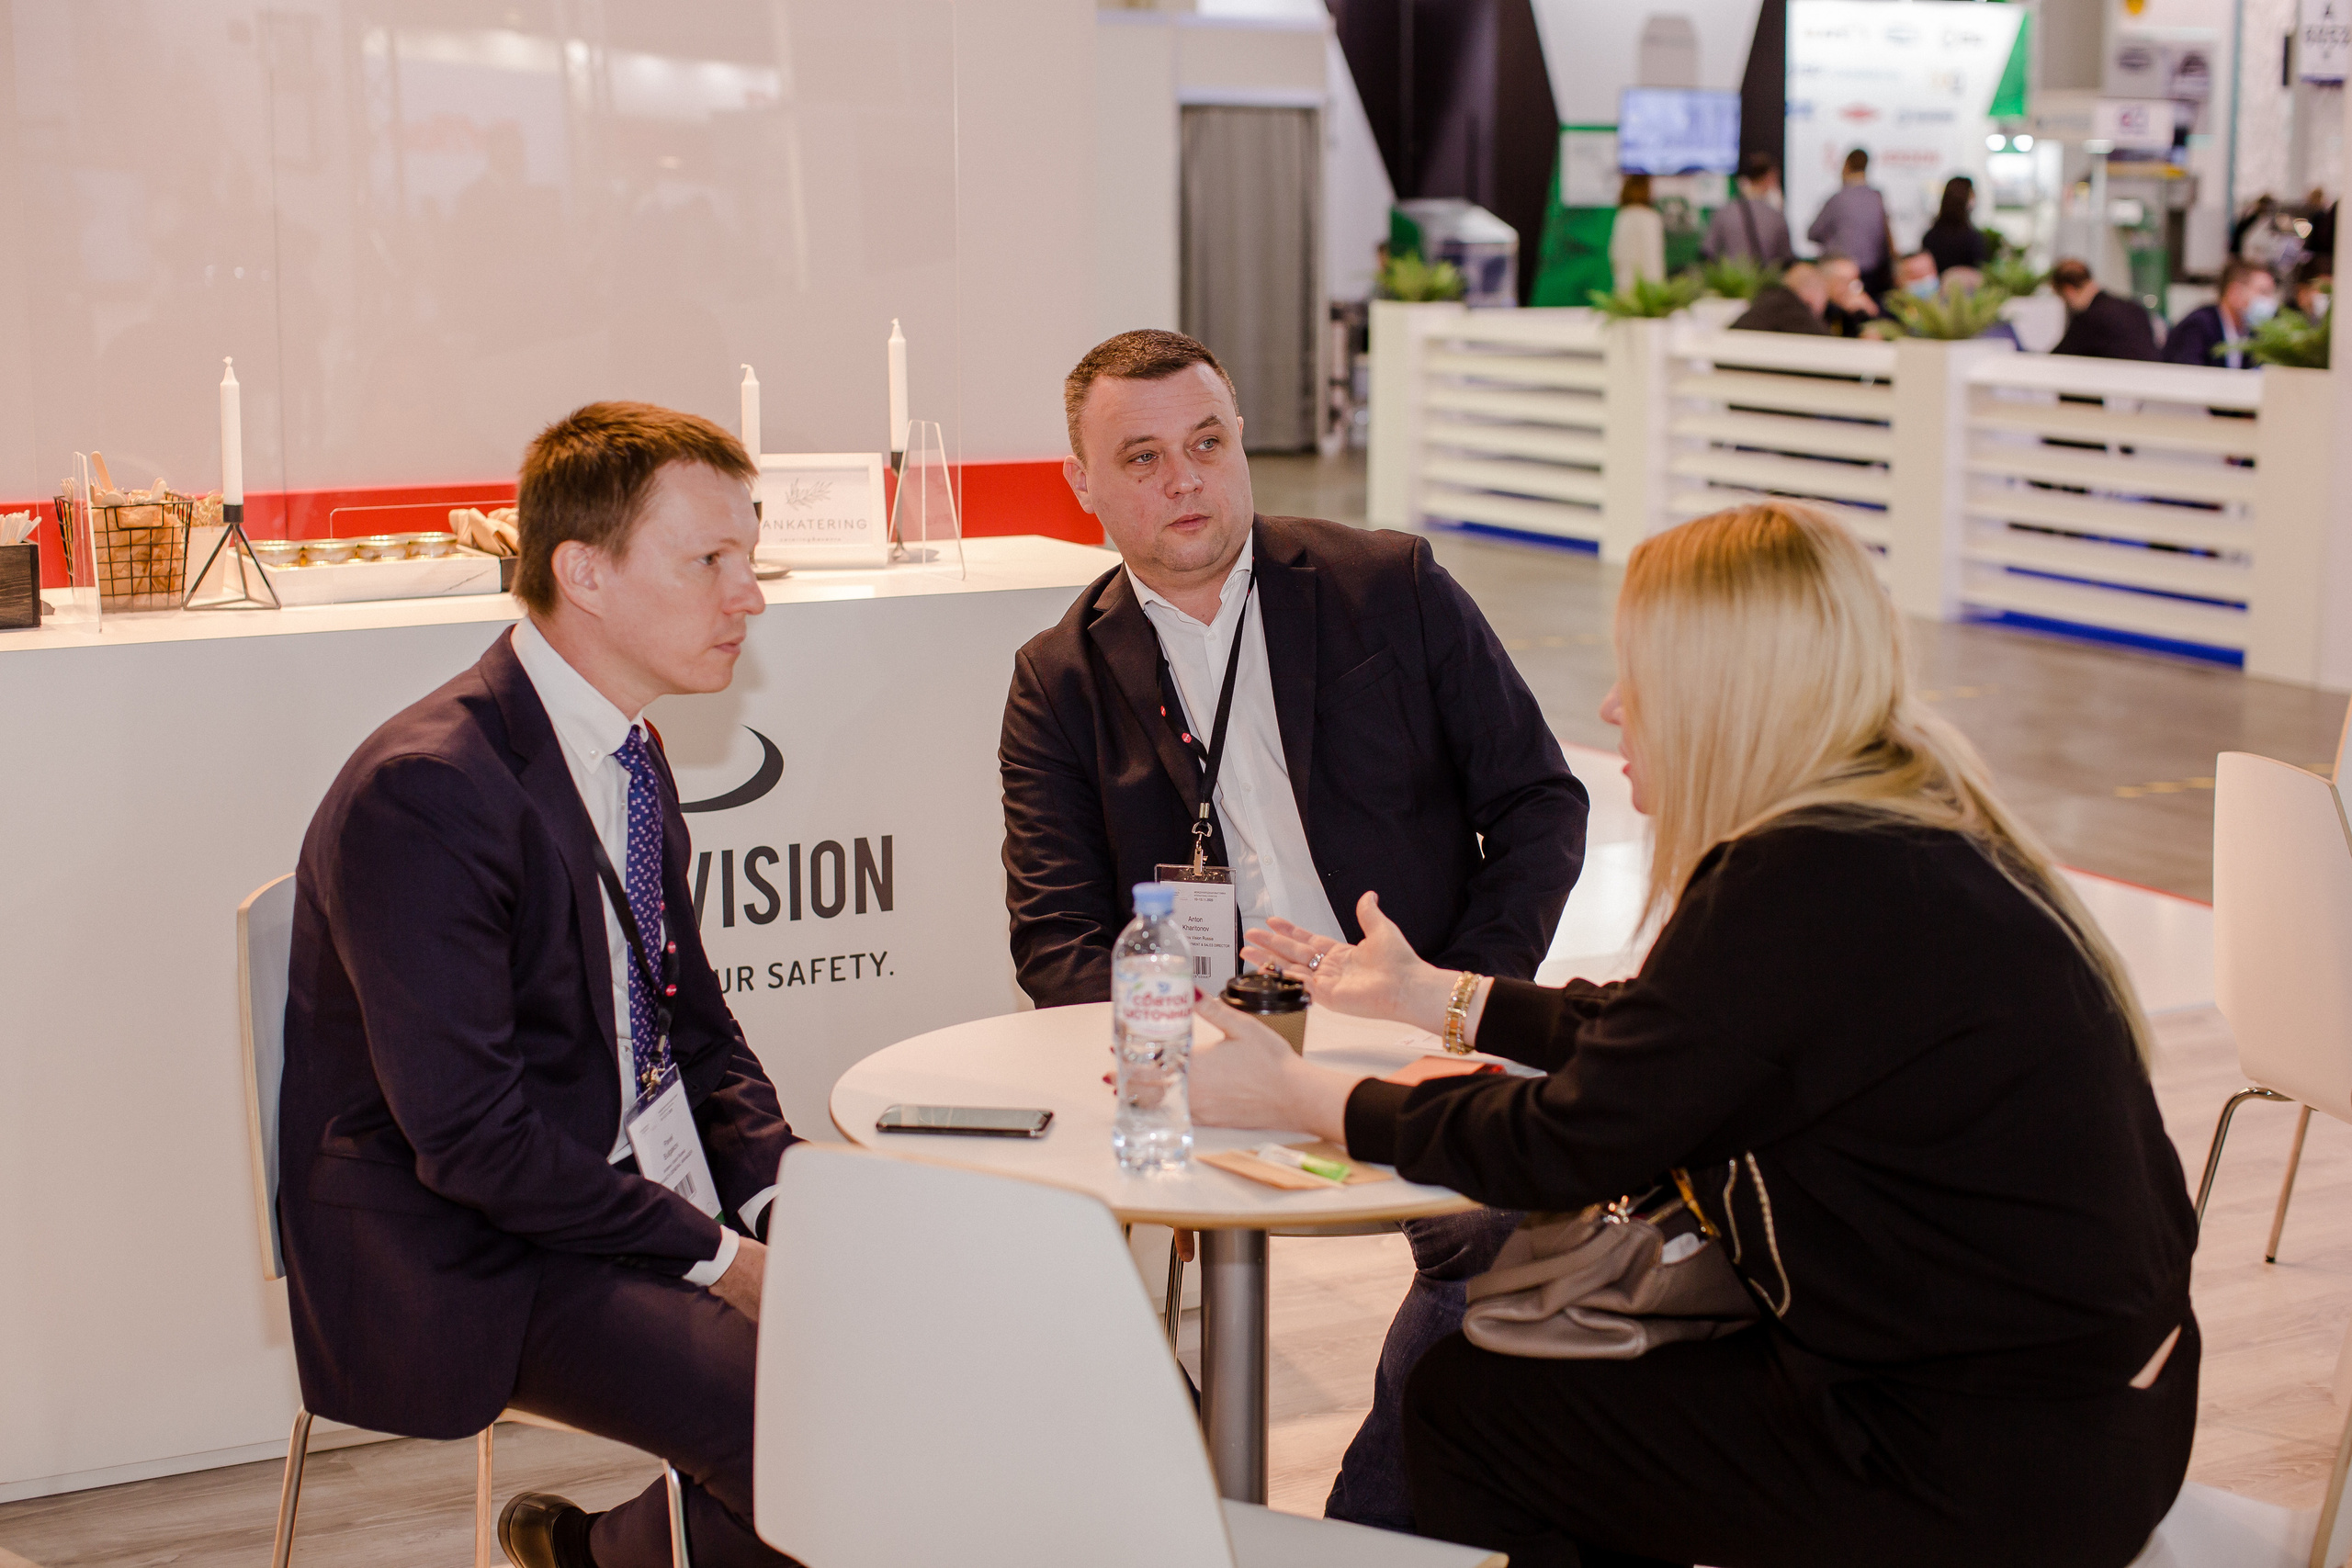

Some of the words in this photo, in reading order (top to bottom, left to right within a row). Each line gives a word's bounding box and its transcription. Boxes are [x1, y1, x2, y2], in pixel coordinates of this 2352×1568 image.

[693, 834, 894, 931] VISION
[715, 965, 754, 995] UR
[768, 951, 894, 989] SAFETY.
